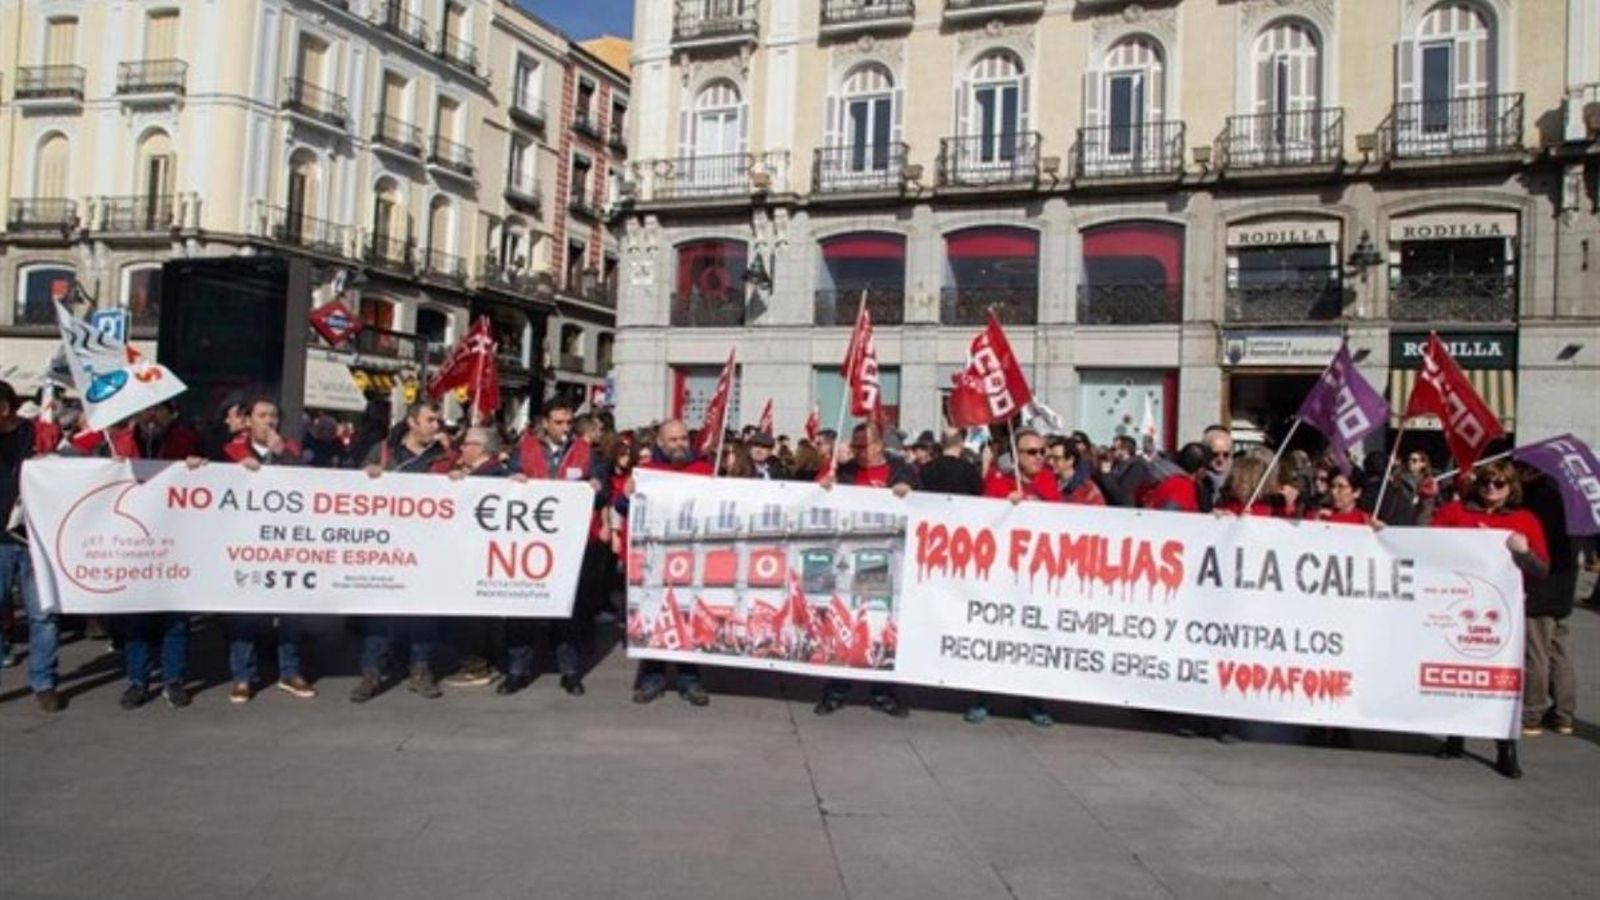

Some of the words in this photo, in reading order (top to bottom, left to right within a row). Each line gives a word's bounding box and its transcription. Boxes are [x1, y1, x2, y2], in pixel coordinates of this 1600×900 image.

[1239, 229, 1327, 245] RODILLA
[1403, 222, 1502, 238] RODILLA
[1403, 342, 1503, 357] ROILLA
[167, 487, 212, 510] NO
[218, 489, 239, 511] A
[246, 490, 304, 514] LOS
[313, 493, 456, 519] DESPIDOS
[260, 525, 287, 542] EN
[292, 526, 316, 542] EL
[322, 527, 391, 544] GRUPO
[227, 547, 336, 565] VODAFONE
[343, 547, 418, 566] ESPAÑA
[487, 540, 553, 580] NO
[915, 521, 997, 583] 1200
[1008, 529, 1185, 600] FAMILIAS
[1196, 545, 1223, 589] A
[1234, 546, 1284, 592] LA
[1294, 551, 1415, 602] CALLE
[75, 563, 190, 582] Despedido
[966, 600, 1016, 627] POR
[1021, 605, 1049, 631] EL
[1056, 608, 1157, 640] EMPLEO
[1165, 618, 1179, 642] Y
[1185, 619, 1287, 651] CONTRA
[1294, 627, 1344, 656] LOS
[940, 635, 1105, 673] RECURRENTES
[1177, 657, 1210, 684] DE
[1216, 659, 1353, 703] VODAFONE
[1425, 667, 1491, 687] CCOO
